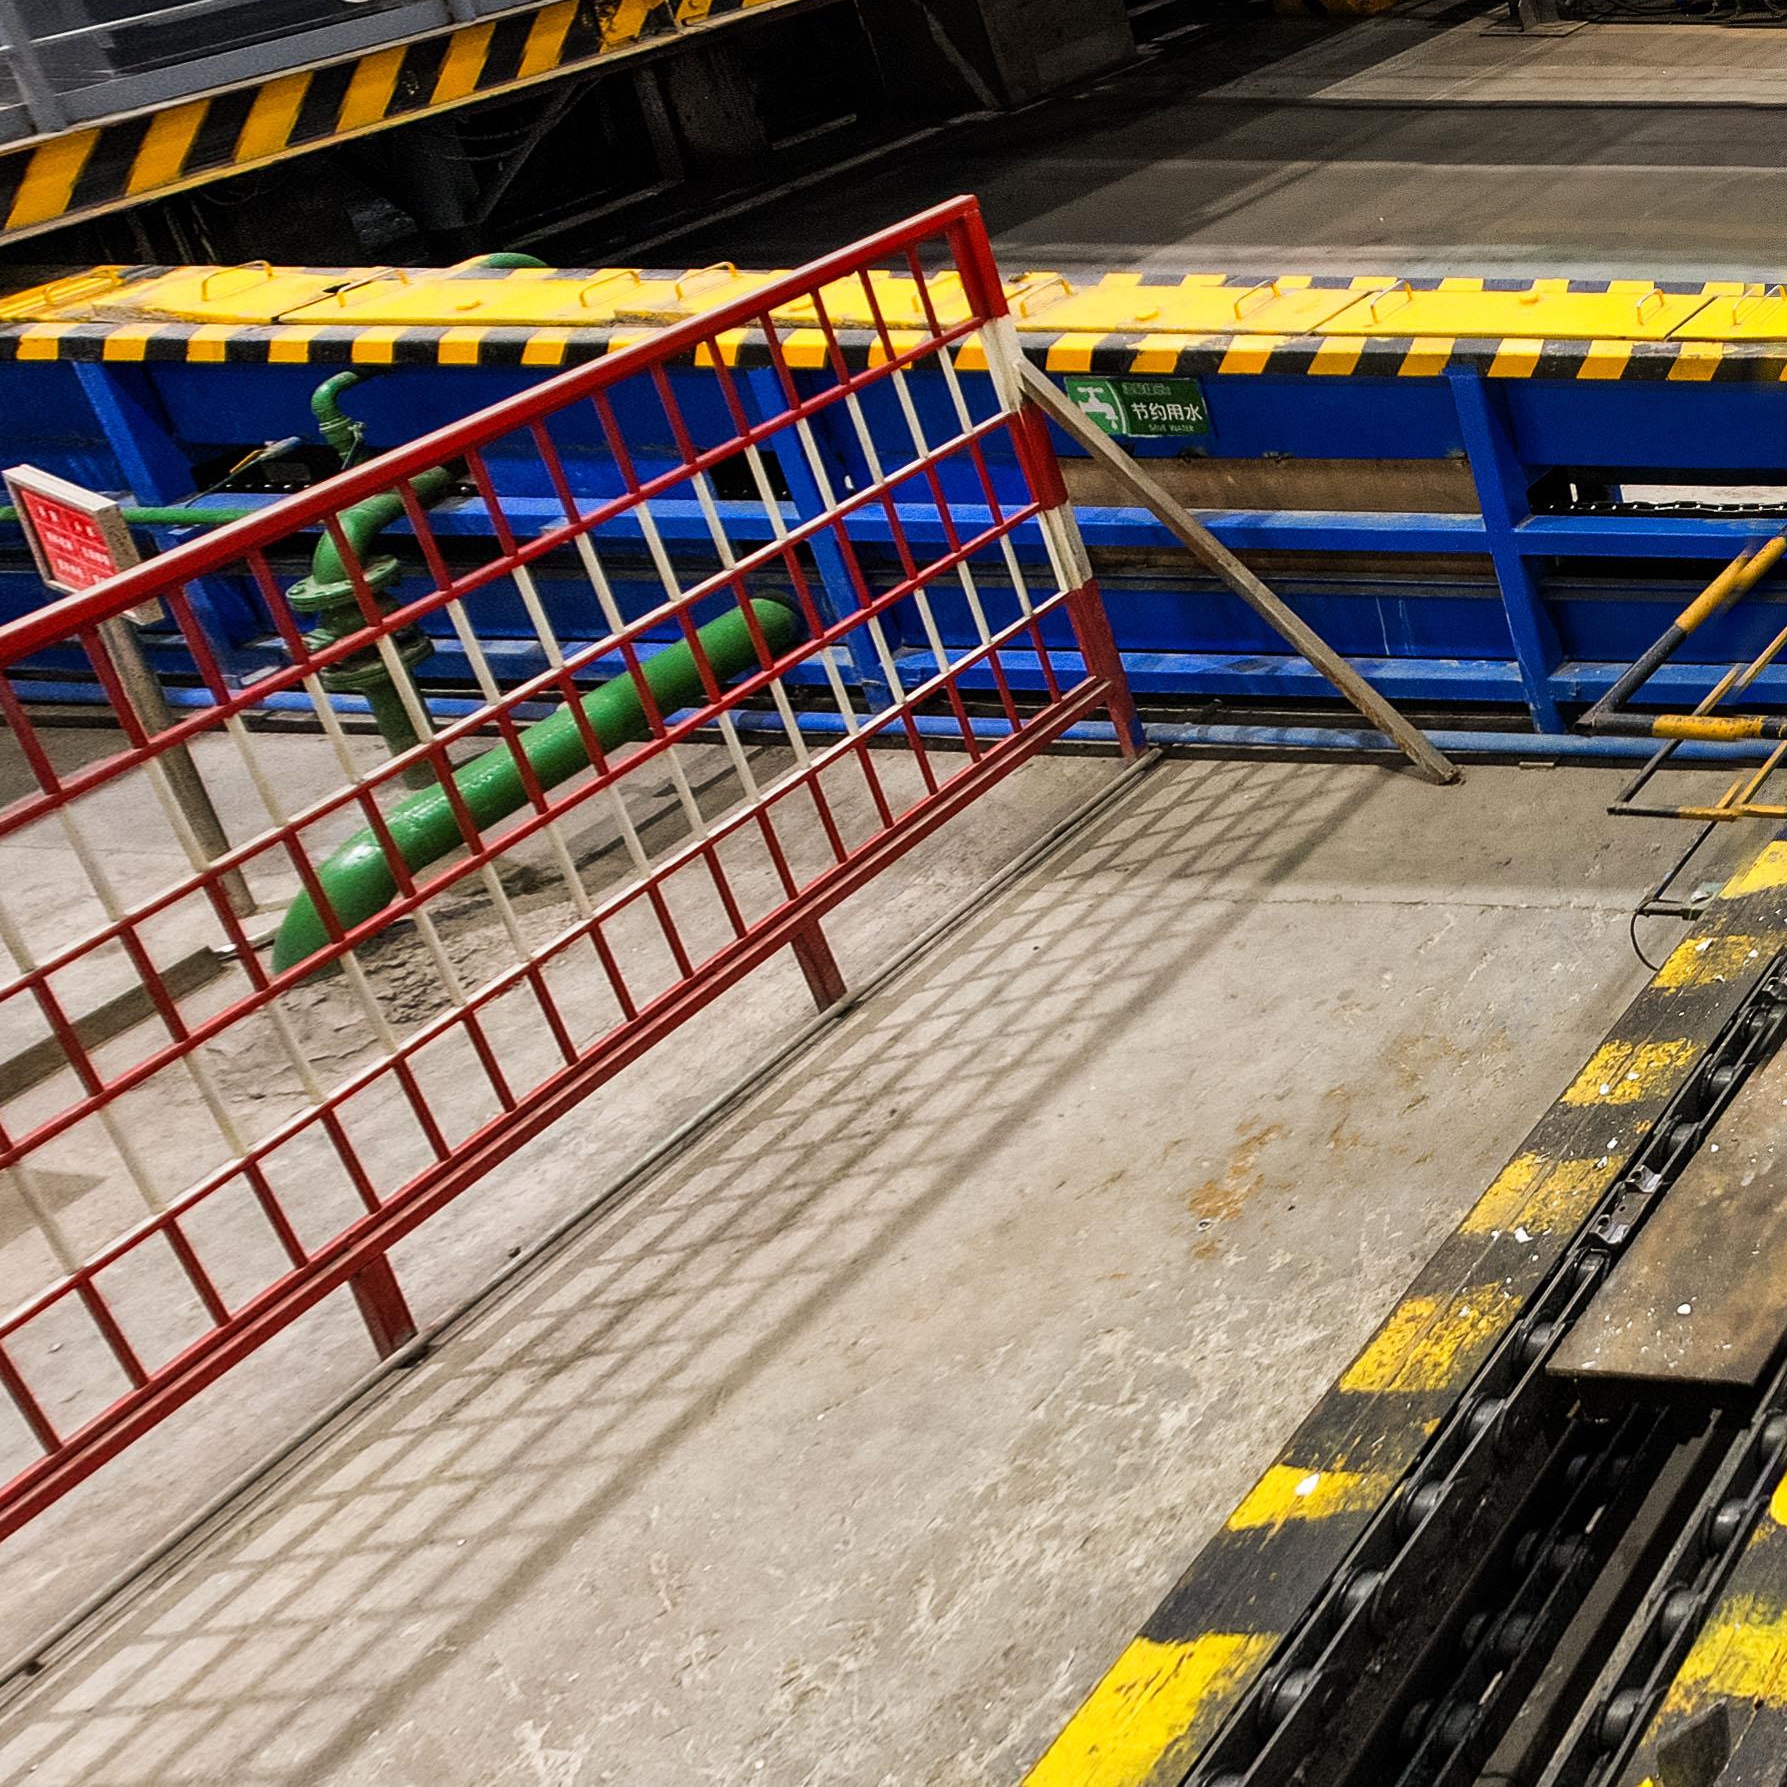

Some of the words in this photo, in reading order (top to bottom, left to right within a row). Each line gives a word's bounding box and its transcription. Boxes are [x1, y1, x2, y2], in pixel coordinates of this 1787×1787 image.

[1131, 402, 1204, 421] 节约用水
[1170, 424, 1195, 432] WATER
